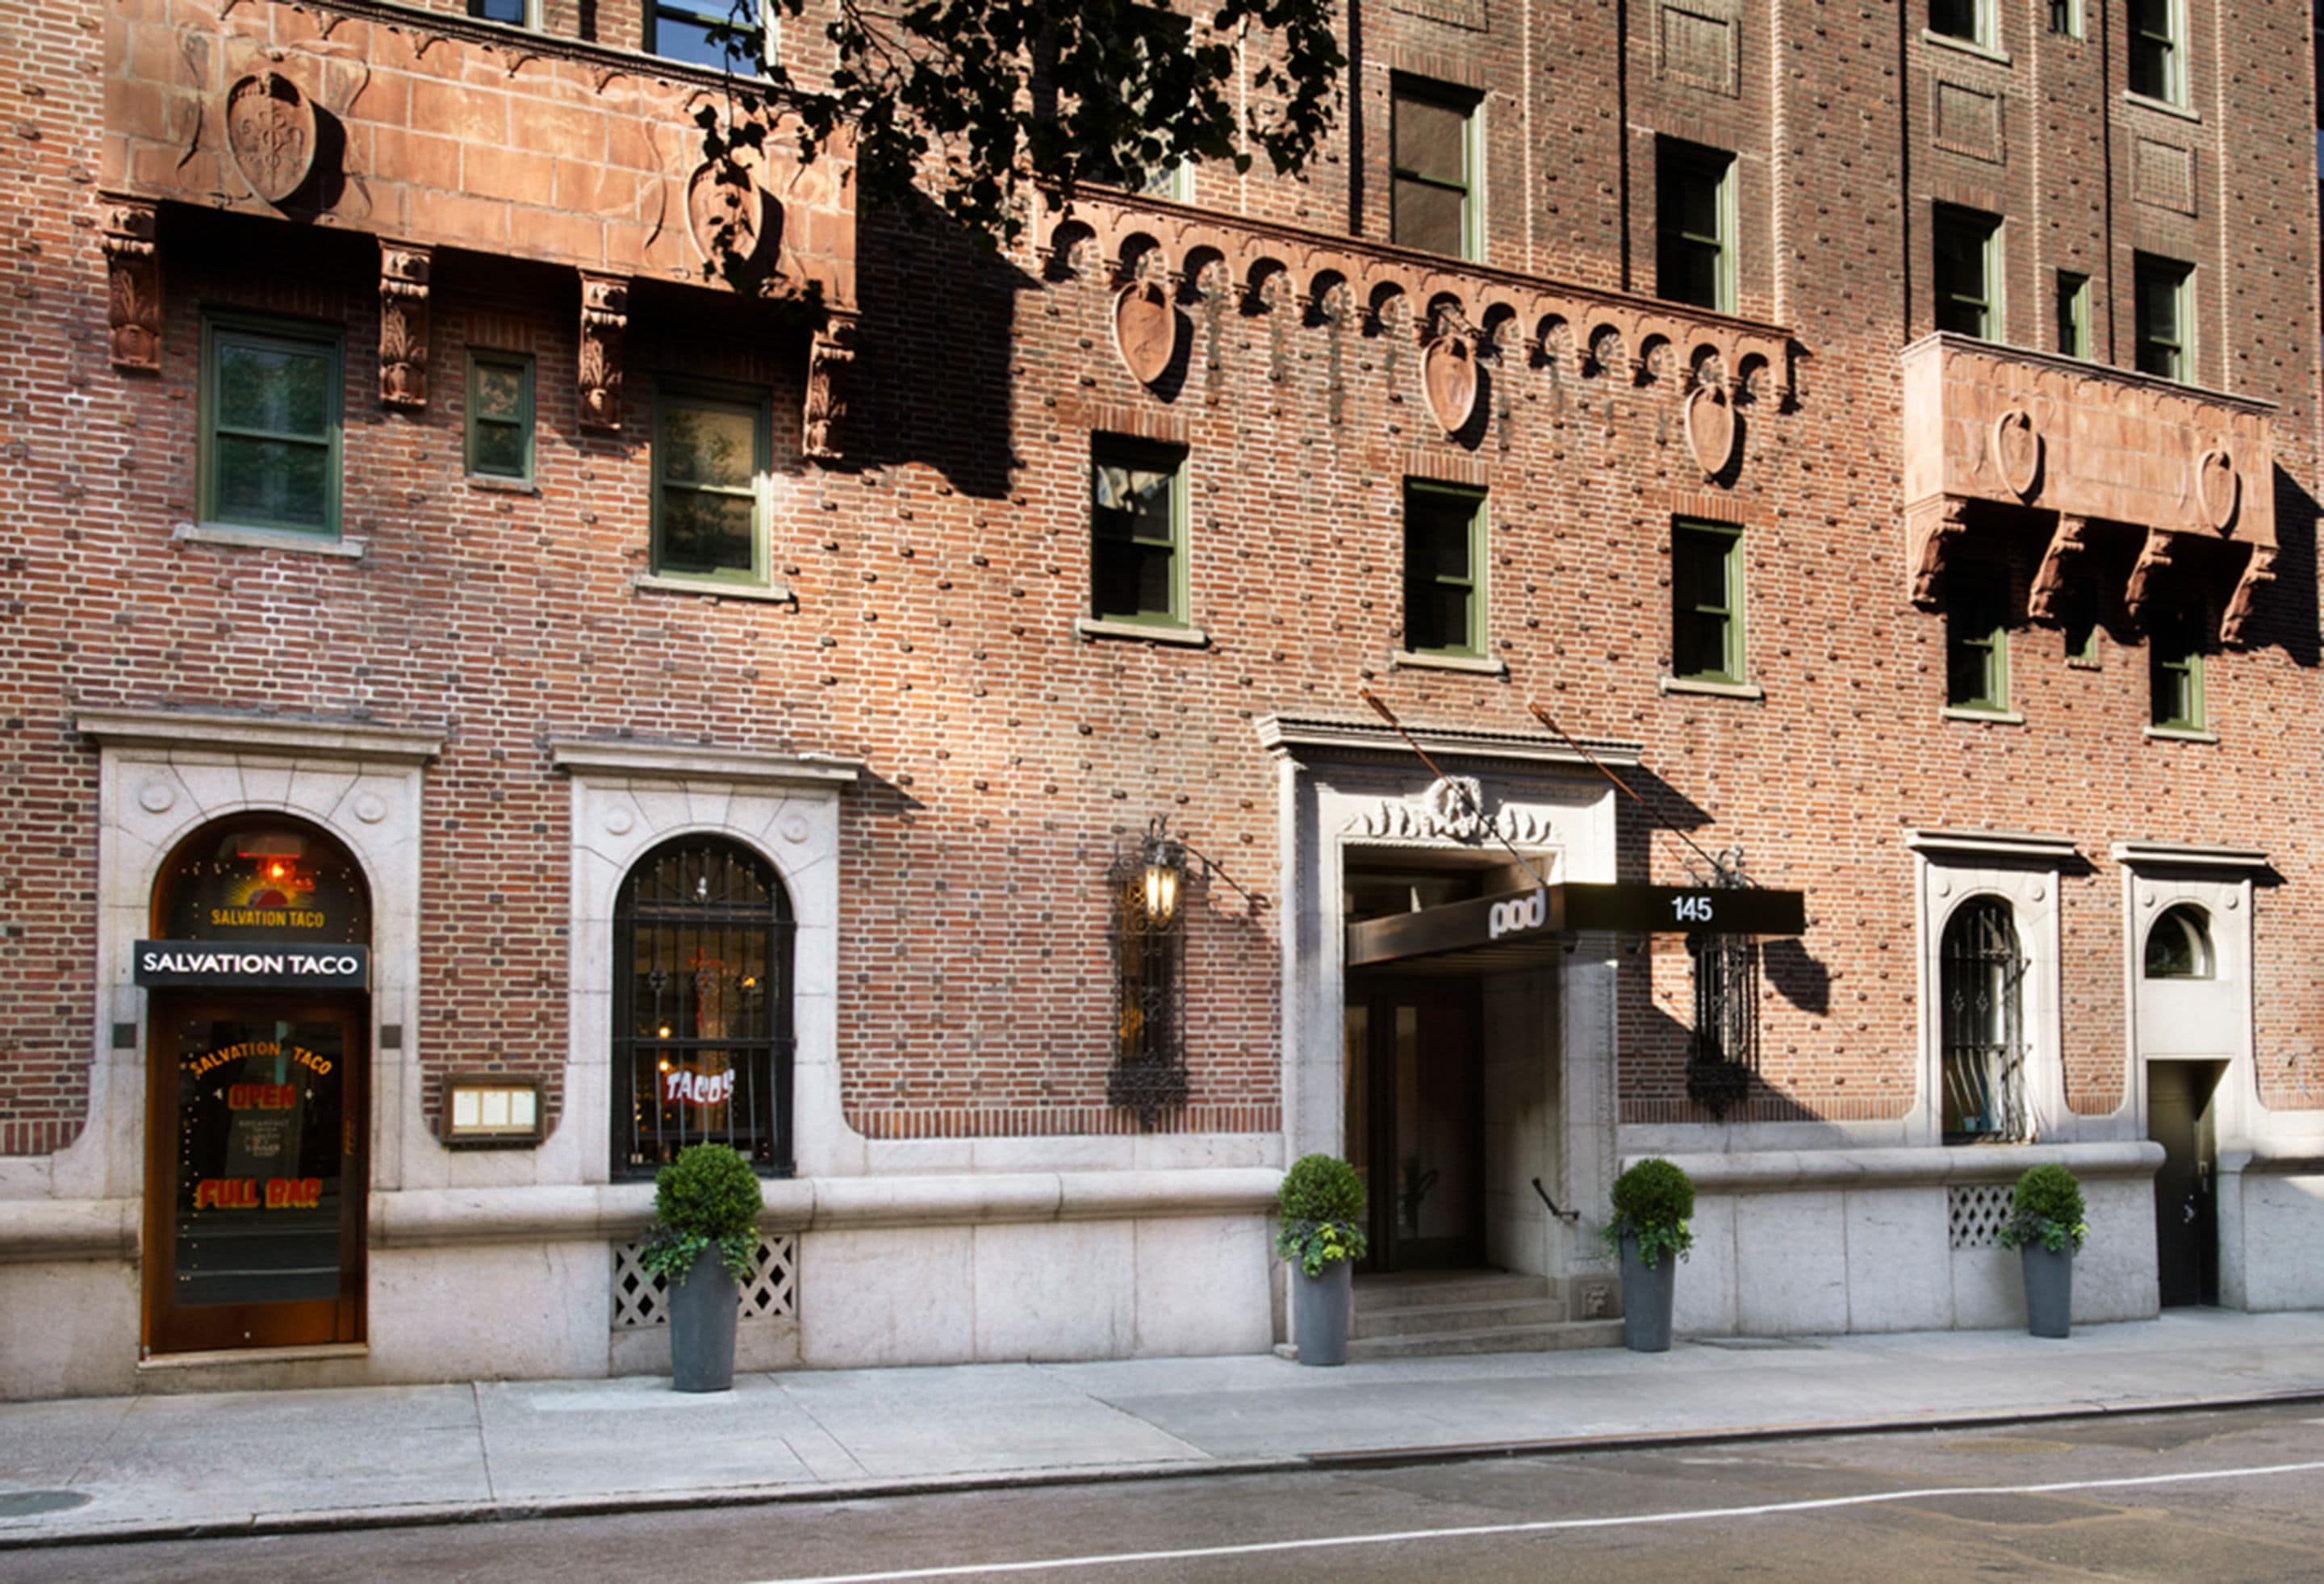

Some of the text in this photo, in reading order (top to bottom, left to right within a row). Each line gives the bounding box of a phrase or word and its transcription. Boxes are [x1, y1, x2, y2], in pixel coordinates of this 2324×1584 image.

[211, 909, 324, 928] SALVATION TACO
[1489, 888, 1546, 938] pod
[1672, 896, 1712, 921] 145
[144, 952, 357, 974] SALVATION TACO
[190, 1042, 332, 1076] SALVATION TACO
[228, 1084, 295, 1110] OPEN
[667, 1068, 735, 1103] TACOS
[196, 1178, 321, 1208] FULL BAR
